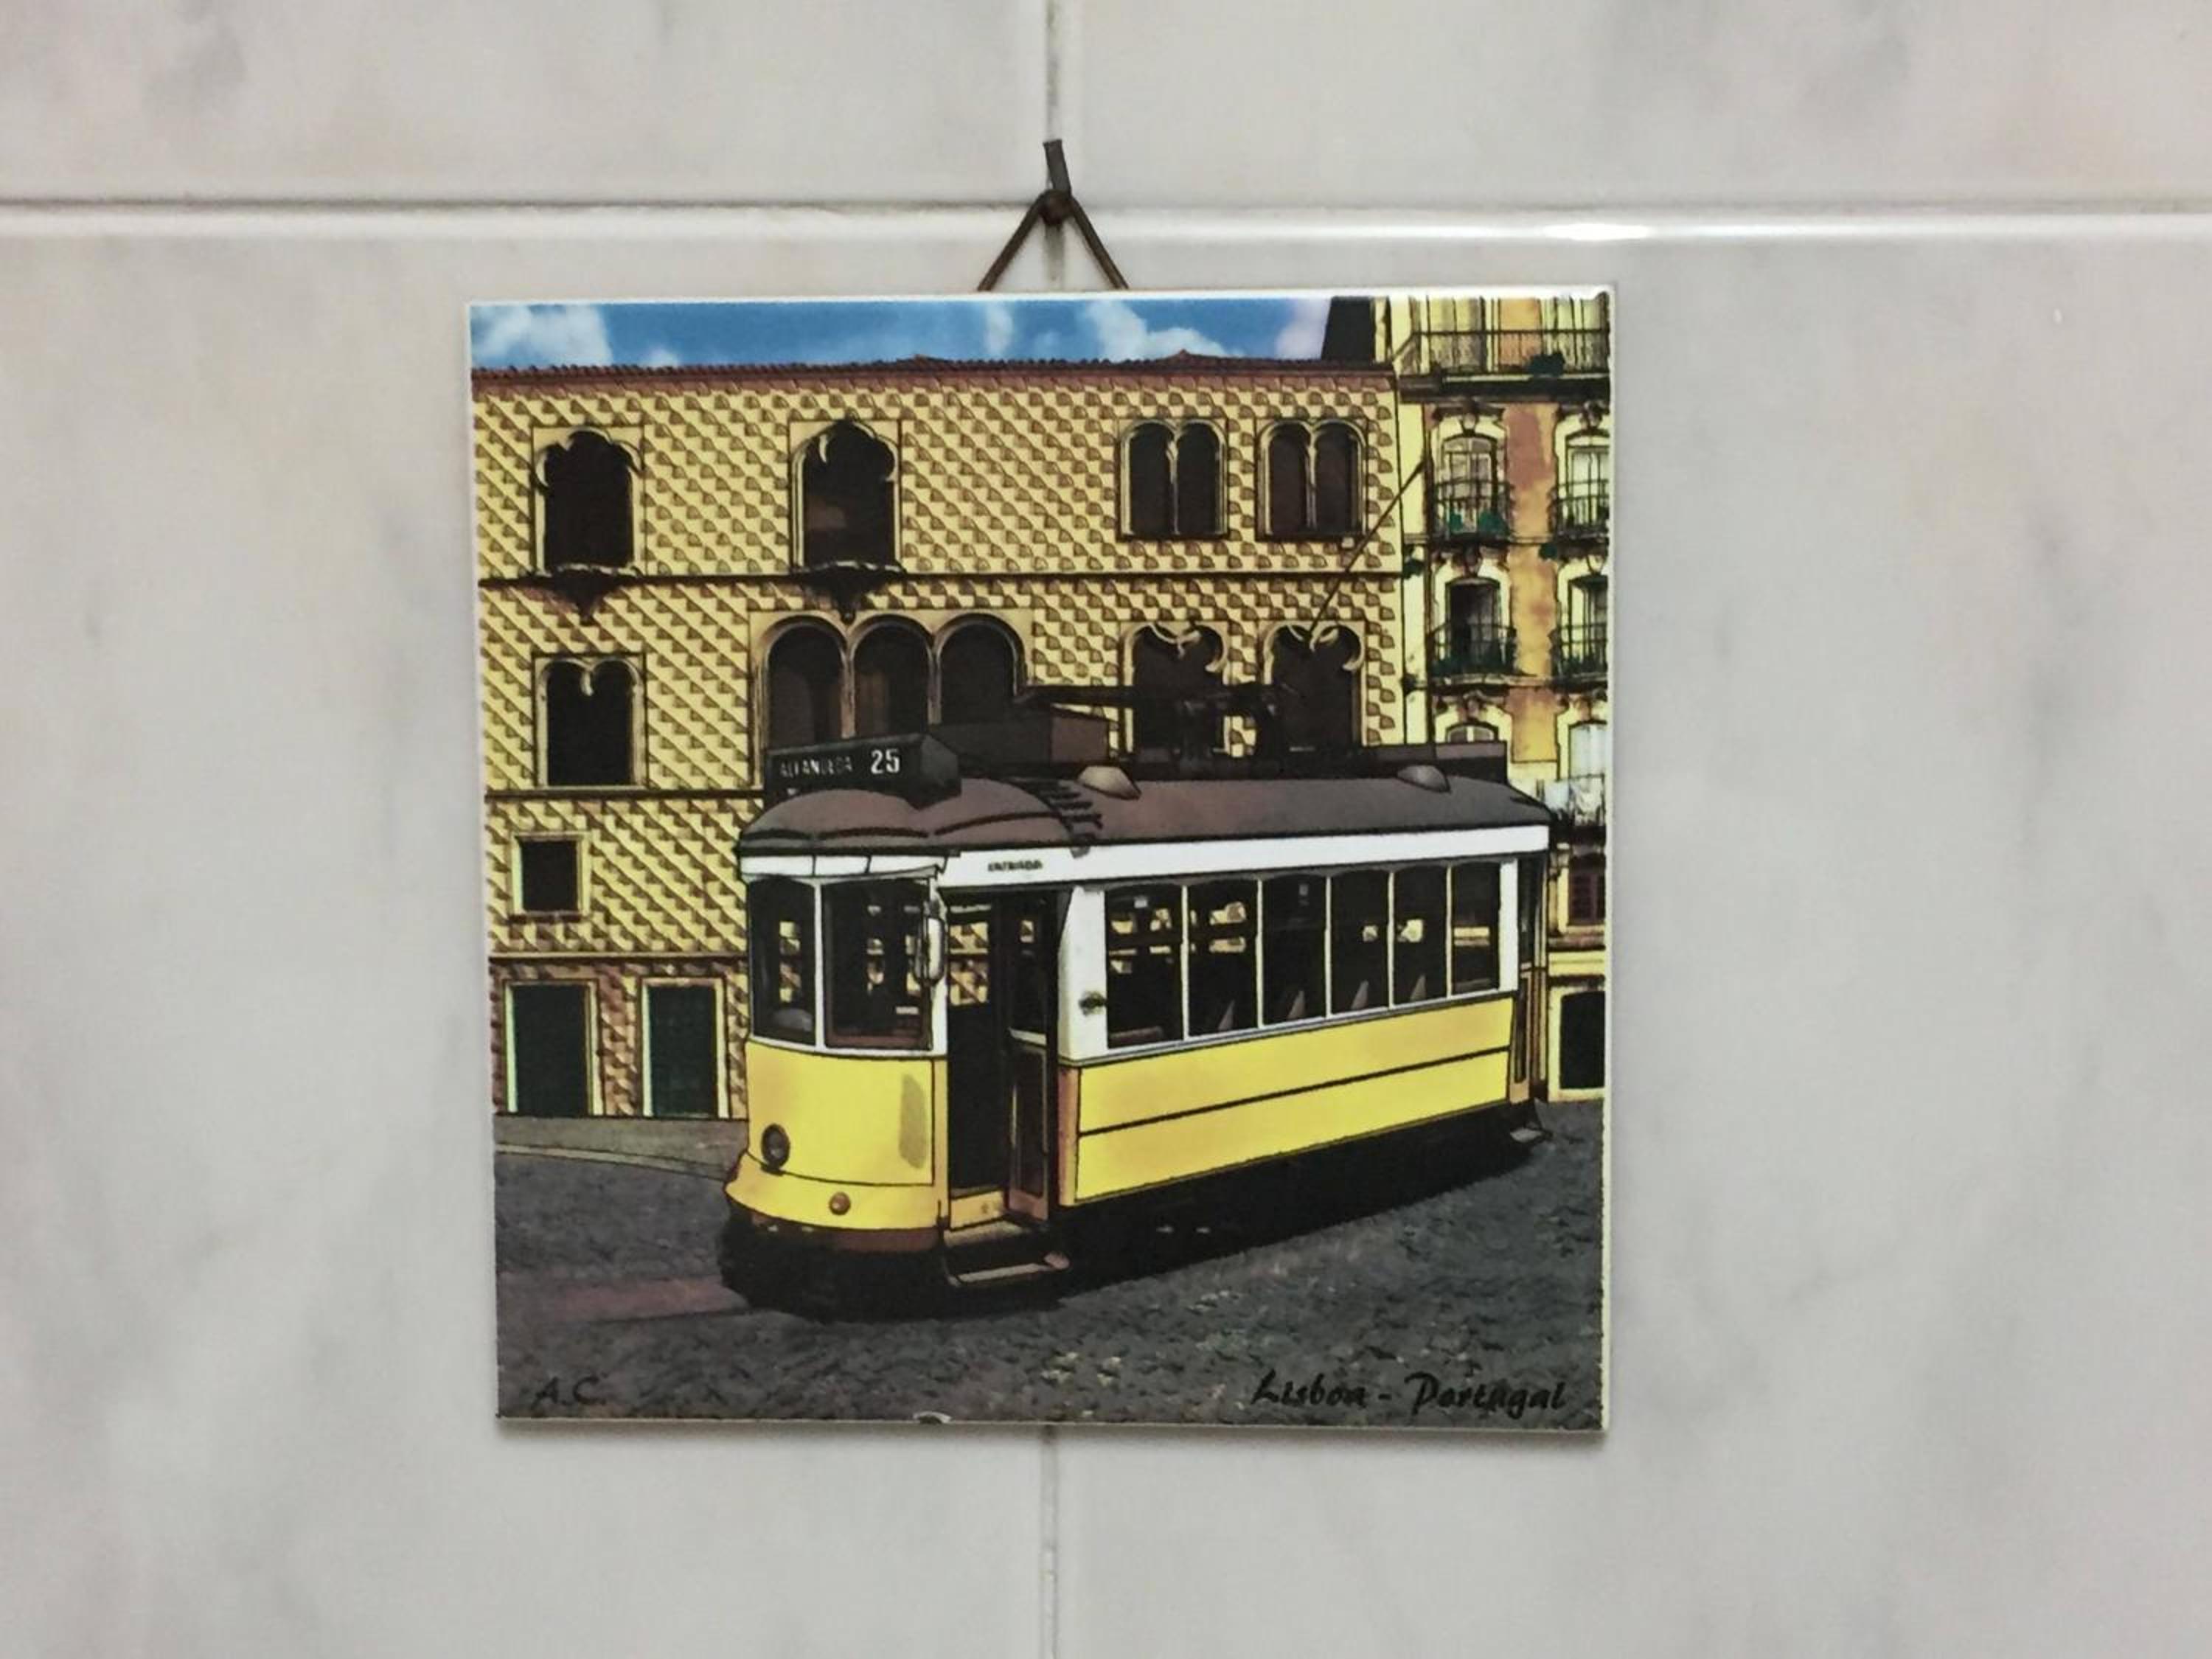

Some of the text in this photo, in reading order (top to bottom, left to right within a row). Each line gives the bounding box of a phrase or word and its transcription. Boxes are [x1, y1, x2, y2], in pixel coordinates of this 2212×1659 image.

[871, 748, 900, 774] 25
[1251, 1368, 1368, 1409] Lisboa
[1404, 1371, 1567, 1419] Portugal
